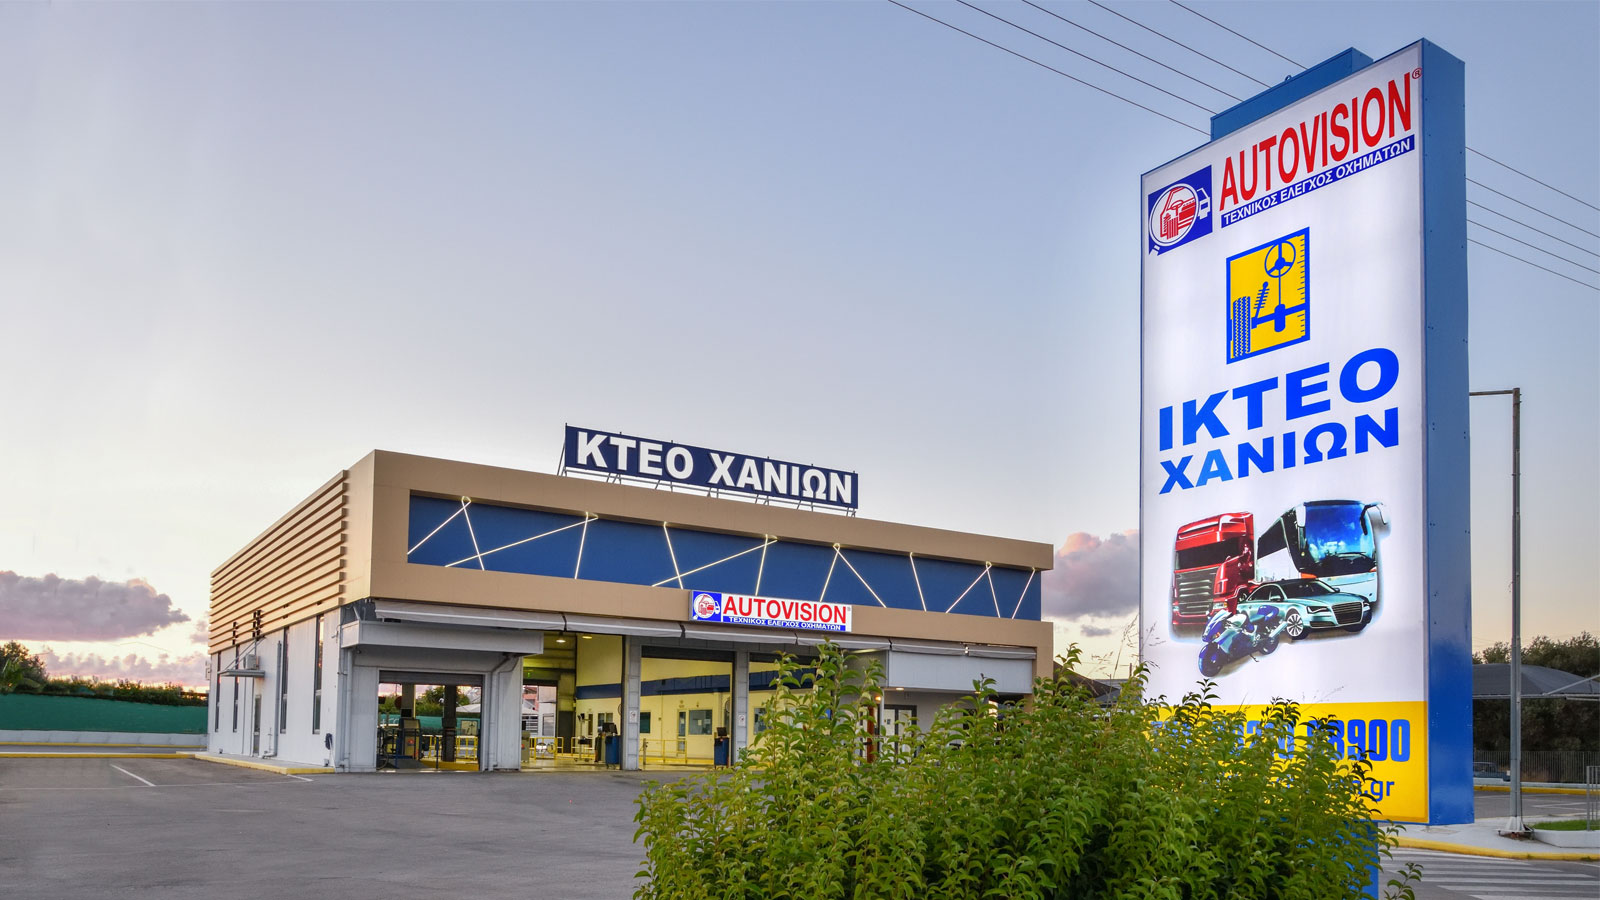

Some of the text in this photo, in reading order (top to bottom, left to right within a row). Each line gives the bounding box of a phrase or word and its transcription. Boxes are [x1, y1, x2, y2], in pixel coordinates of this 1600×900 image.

[1219, 71, 1412, 212] AUTOVISION
[1224, 138, 1411, 225] ΤΕΧΝΙΚΟΣ ΕΛΕΓΧΟΣ ΟΧΗΜΑΤΩΝ
[1159, 347, 1400, 452] ΙΚΤΕΟ
[576, 430, 852, 504] ΚΤΕΟ ΧΑΝΙΩΝ
[1158, 407, 1399, 495] ΧΑΝΙΩΝ
[723, 596, 847, 624] AUTOVISION
